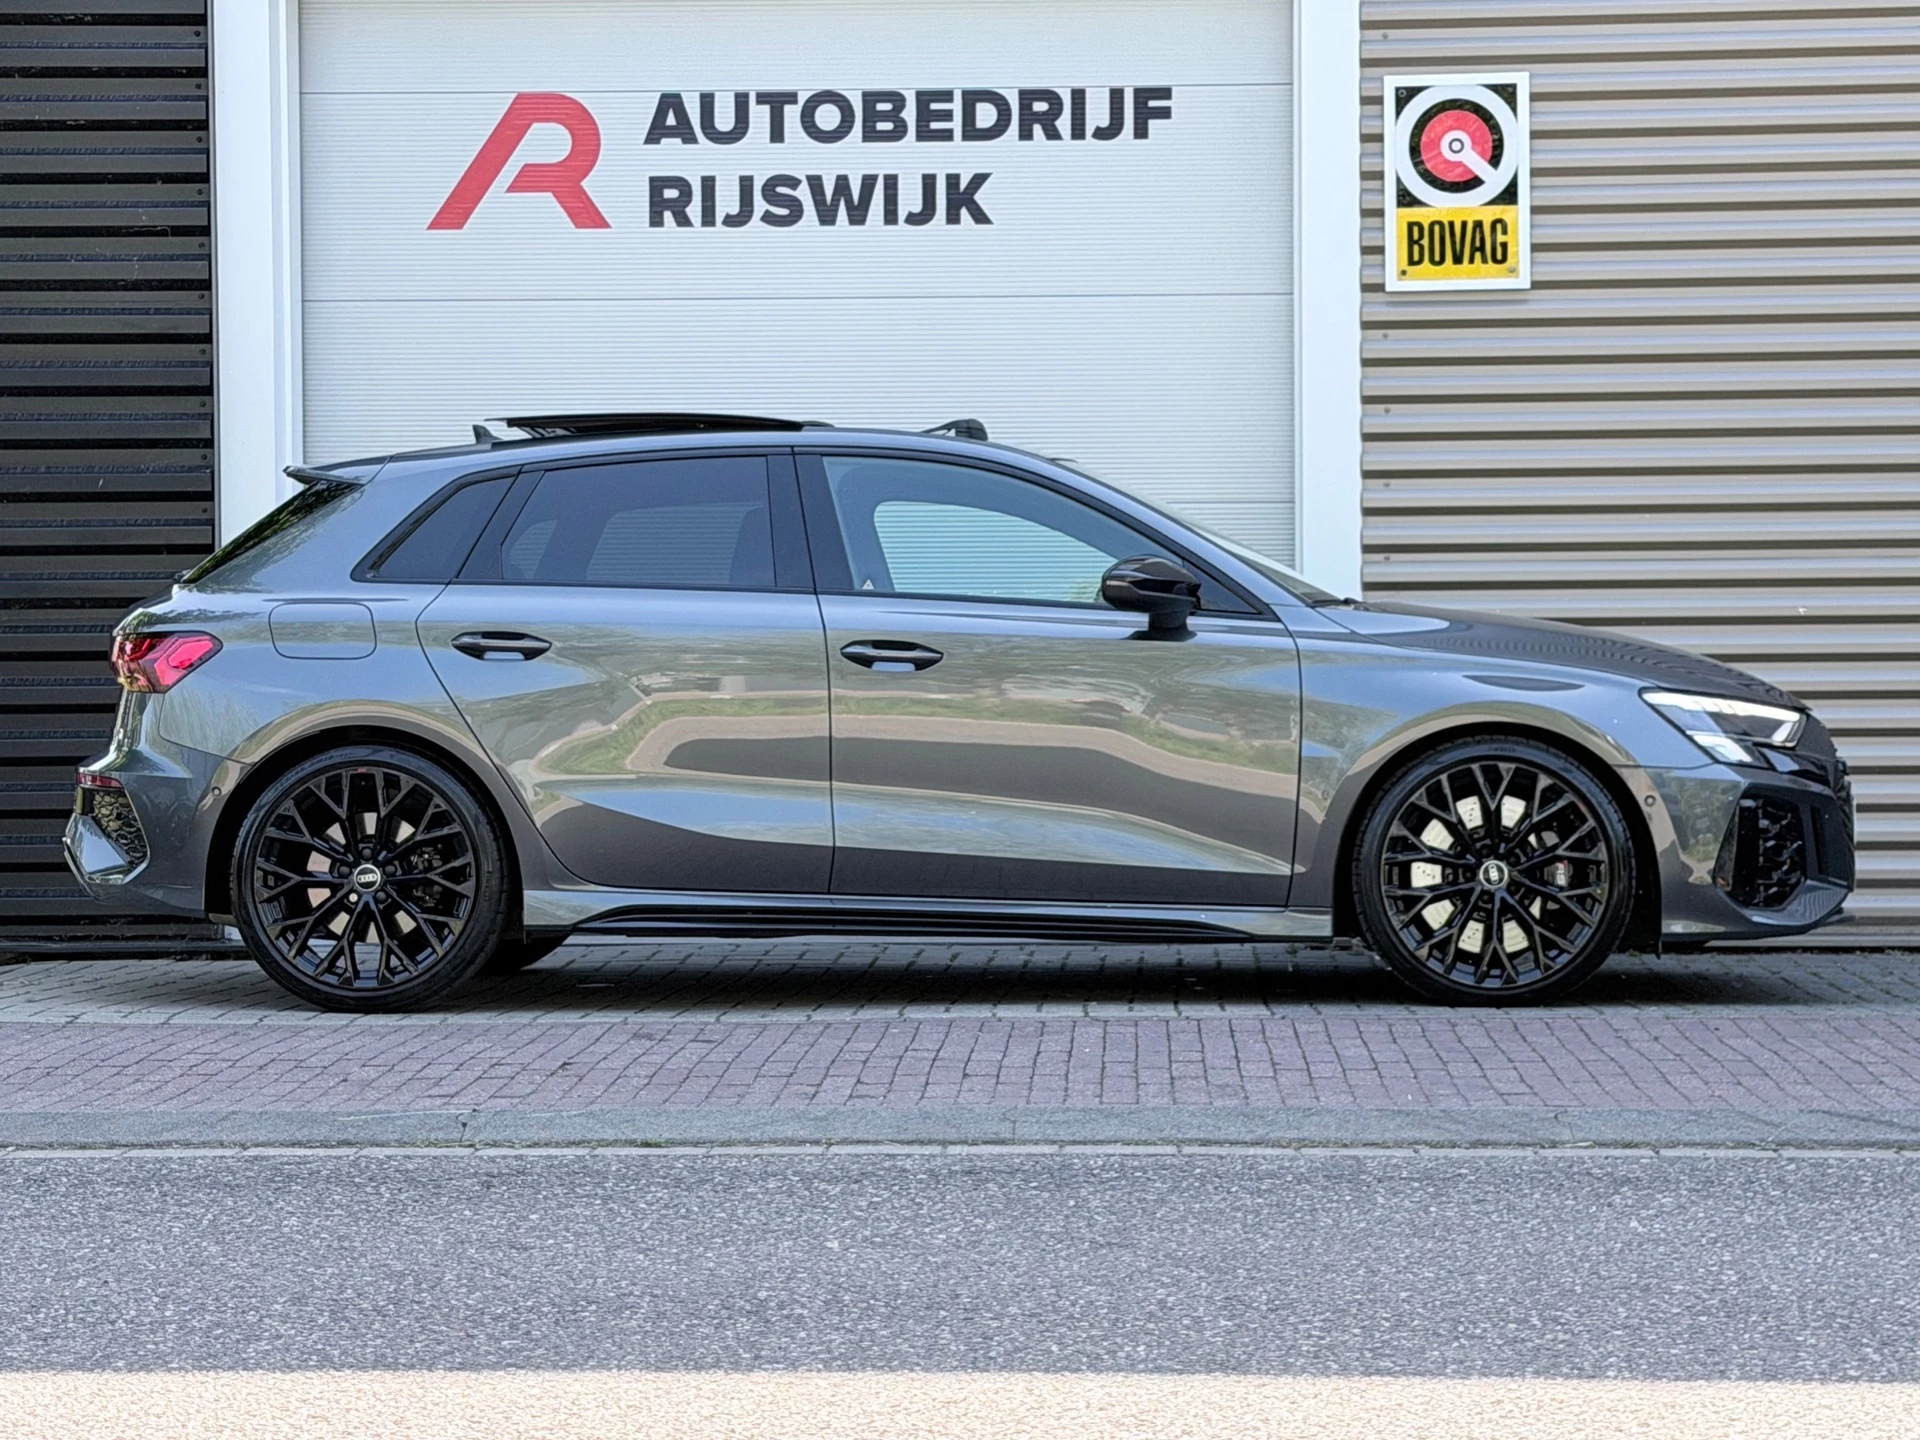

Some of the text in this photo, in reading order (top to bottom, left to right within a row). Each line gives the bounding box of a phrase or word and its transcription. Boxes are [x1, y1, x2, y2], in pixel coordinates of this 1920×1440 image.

[643, 87, 1173, 145] AUTOBEDRIJF
[648, 172, 993, 229] RIJSWIJK
[1406, 217, 1509, 267] BOVAG
